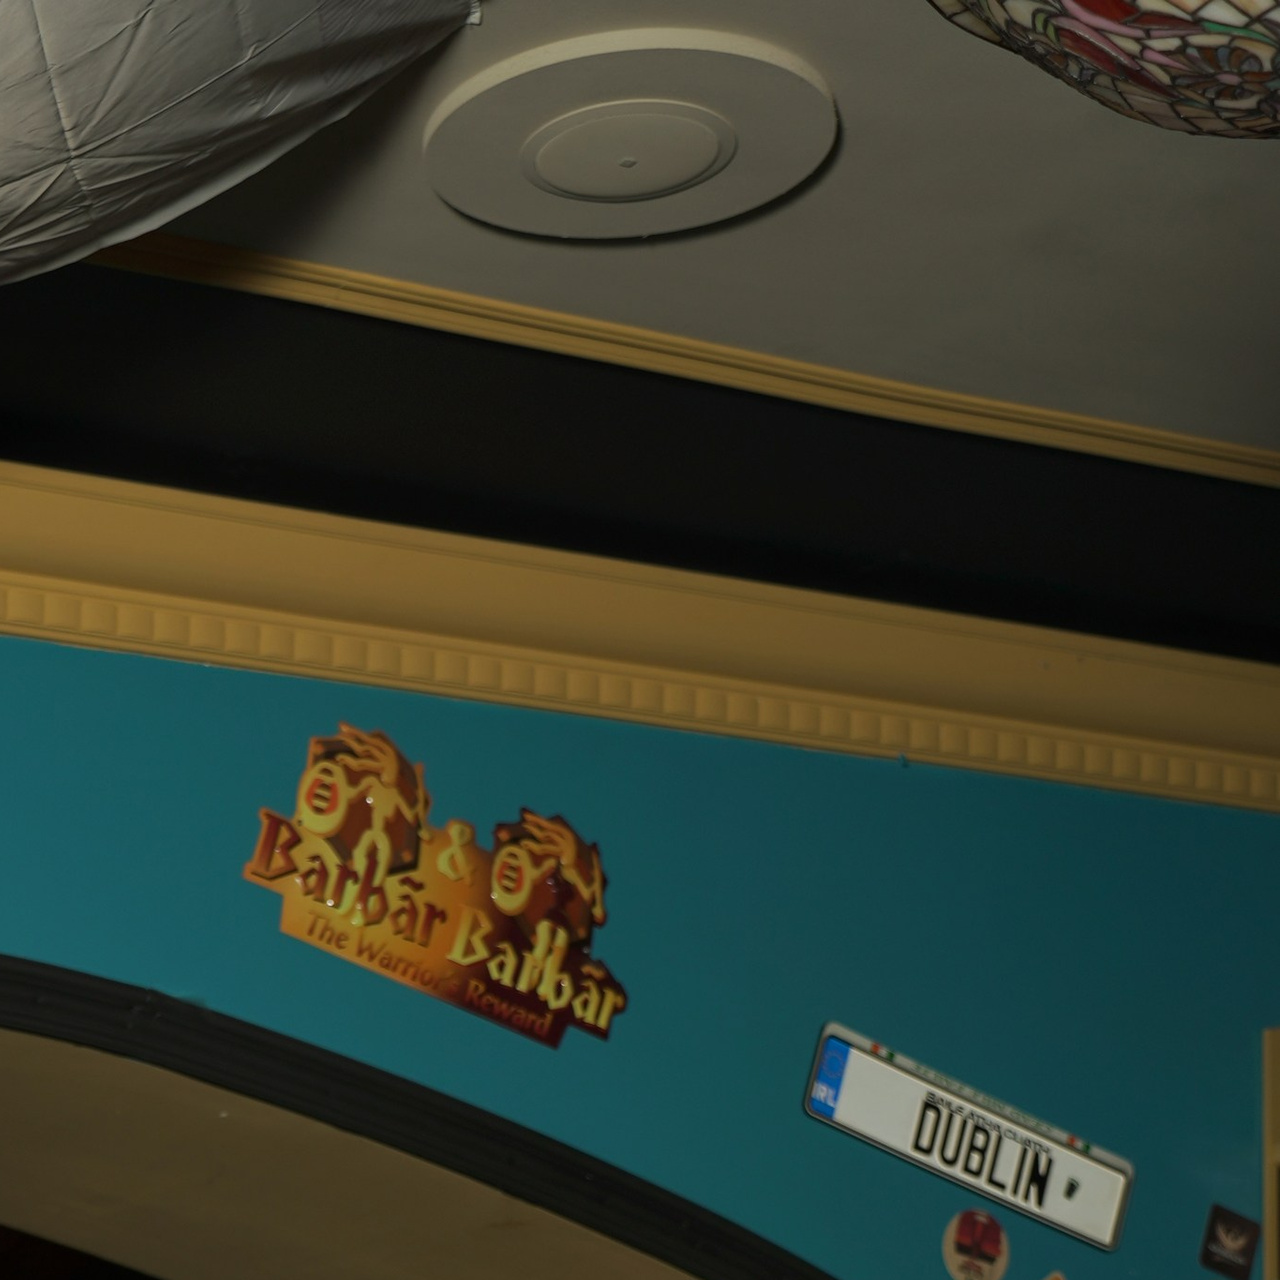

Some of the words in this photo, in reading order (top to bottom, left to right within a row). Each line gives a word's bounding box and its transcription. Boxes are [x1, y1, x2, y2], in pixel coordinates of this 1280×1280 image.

[437, 818, 476, 883] &
[306, 911, 347, 951] The
[466, 978, 554, 1039] Reward
[811, 1081, 836, 1107] IRL
[914, 1101, 1053, 1207] DUBLIN
